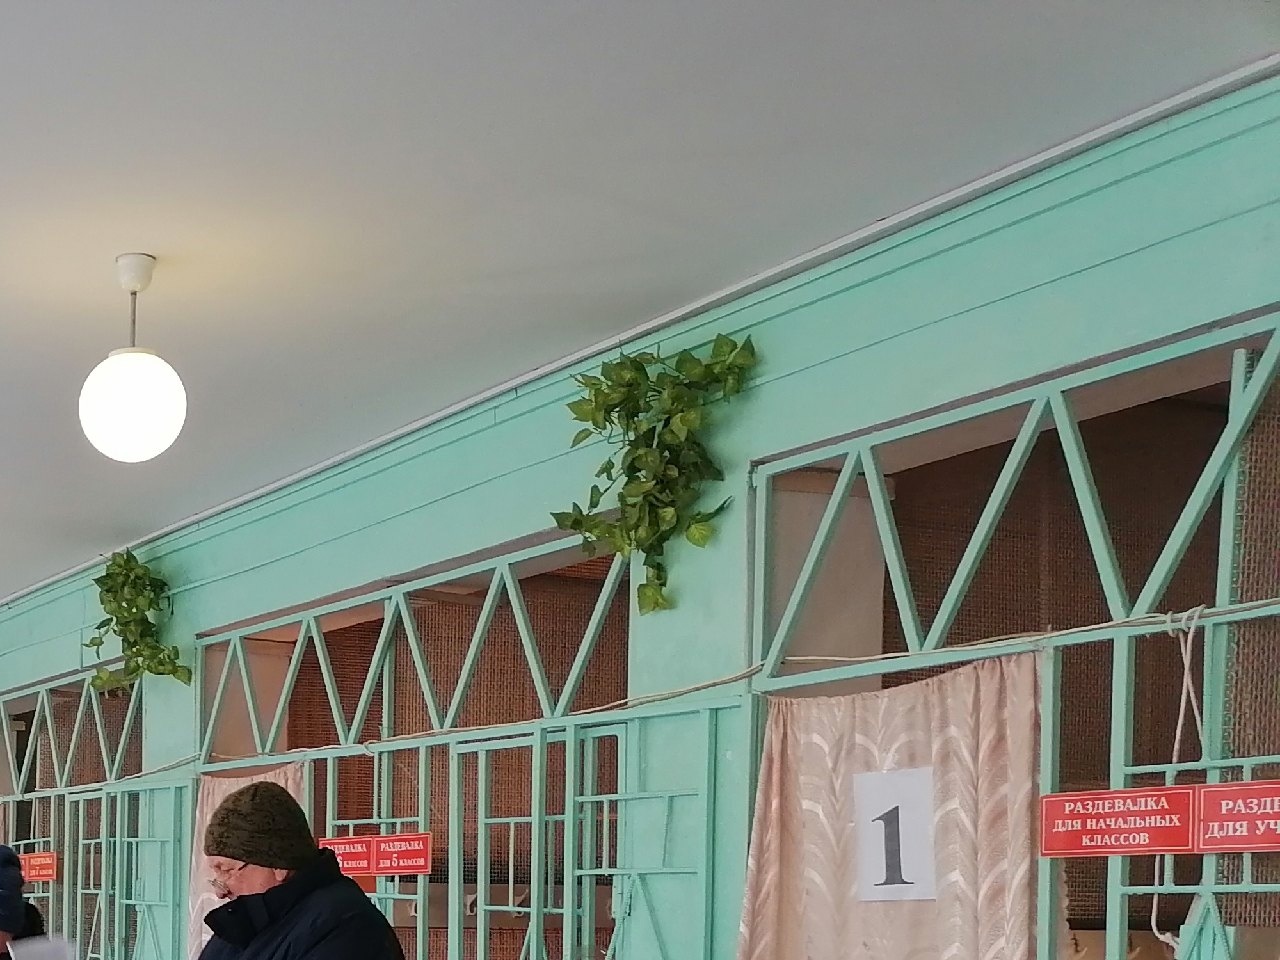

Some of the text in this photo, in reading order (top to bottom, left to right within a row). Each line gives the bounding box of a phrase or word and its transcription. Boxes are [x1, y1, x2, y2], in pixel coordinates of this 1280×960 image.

[1064, 796, 1169, 815] РАЗДЕВАЛКА
[1052, 814, 1182, 833] ДЛЯ НАЧАЛЬНЫХ
[1205, 821, 1249, 839] ДЛЯ
[380, 840, 424, 852] РАЗДЕВАЛКА
[871, 804, 915, 887] 1
[1081, 833, 1150, 847] КЛАССОВ
[391, 853, 398, 867] 5
